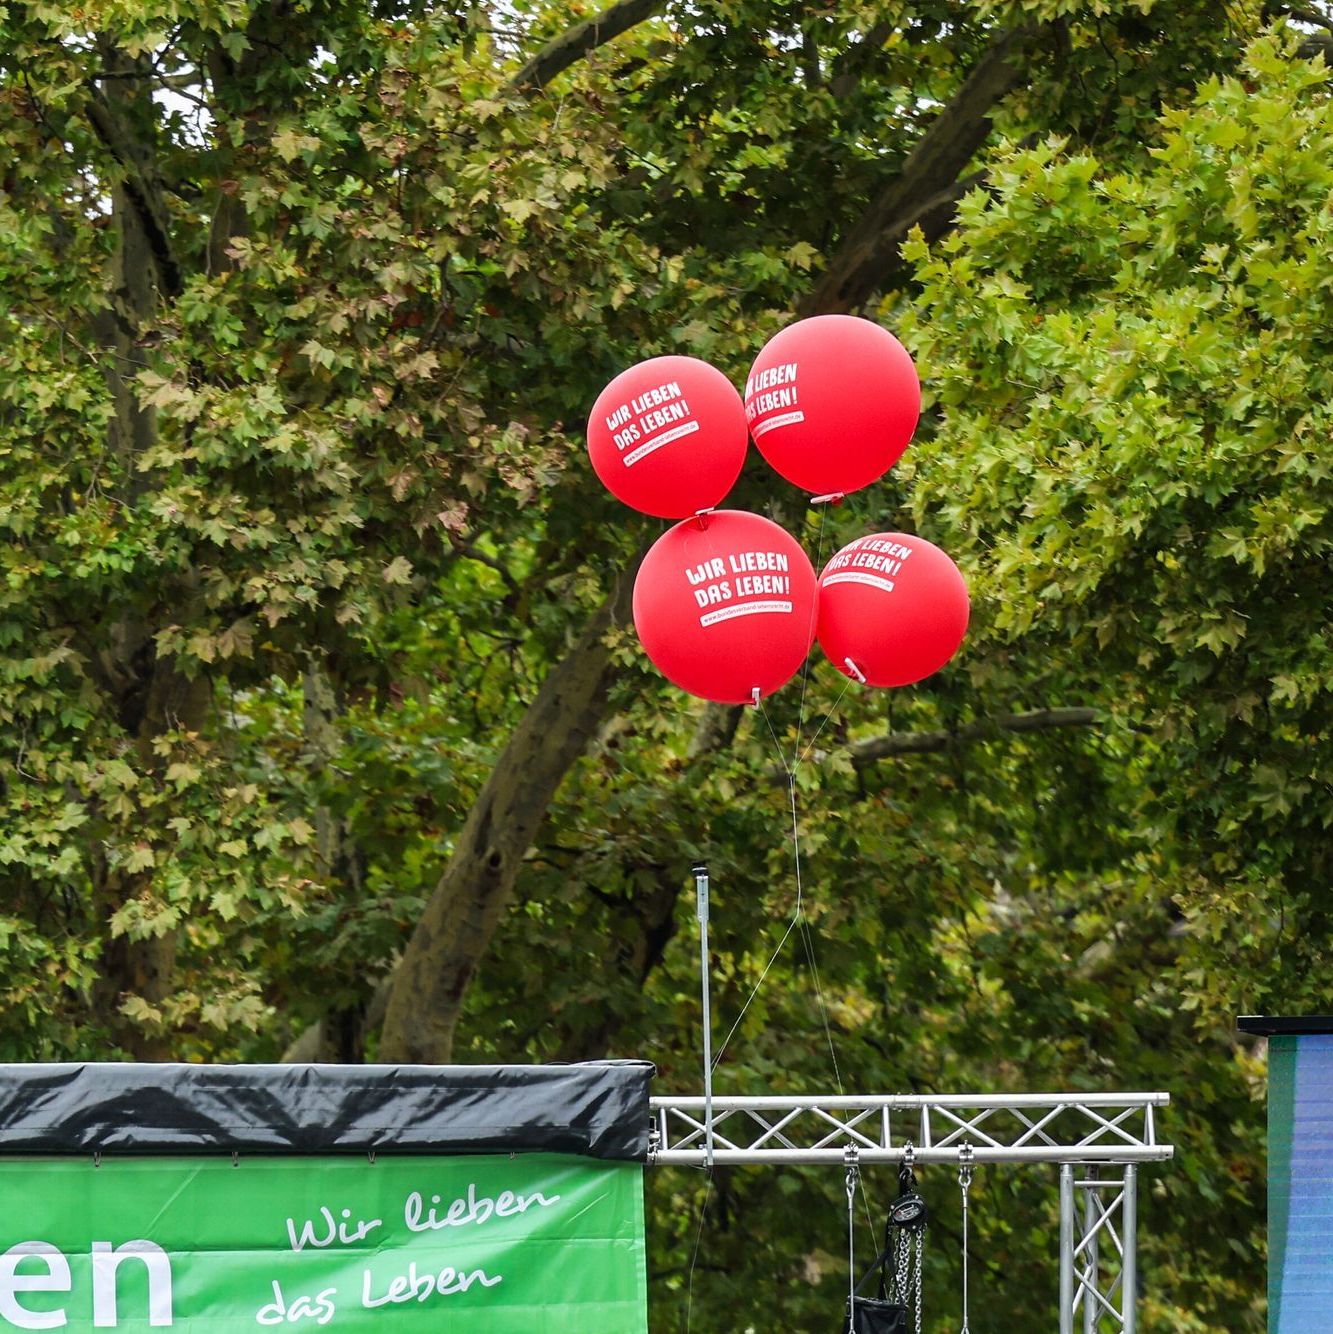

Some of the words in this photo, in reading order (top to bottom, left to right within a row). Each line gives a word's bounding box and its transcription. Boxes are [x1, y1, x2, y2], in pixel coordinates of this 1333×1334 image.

[754, 362, 798, 393] LIEBEN
[605, 404, 632, 431] WIR
[631, 381, 682, 415] LIEBEN
[756, 386, 798, 416] LEBEN!
[613, 423, 641, 451] DAS
[639, 399, 691, 435] LEBEN!
[828, 553, 852, 571] DAS
[851, 552, 902, 577] LEBEN!
[861, 539, 913, 560] LIEBEN
[685, 557, 727, 586] WIR
[729, 552, 789, 573] LIEBEN
[694, 581, 733, 608] DAS
[735, 575, 790, 597] LEBEN!
[286, 1206, 383, 1252] Wir
[404, 1183, 562, 1232] lieben
[256, 1279, 338, 1325] das
[361, 1262, 502, 1308] Leben
